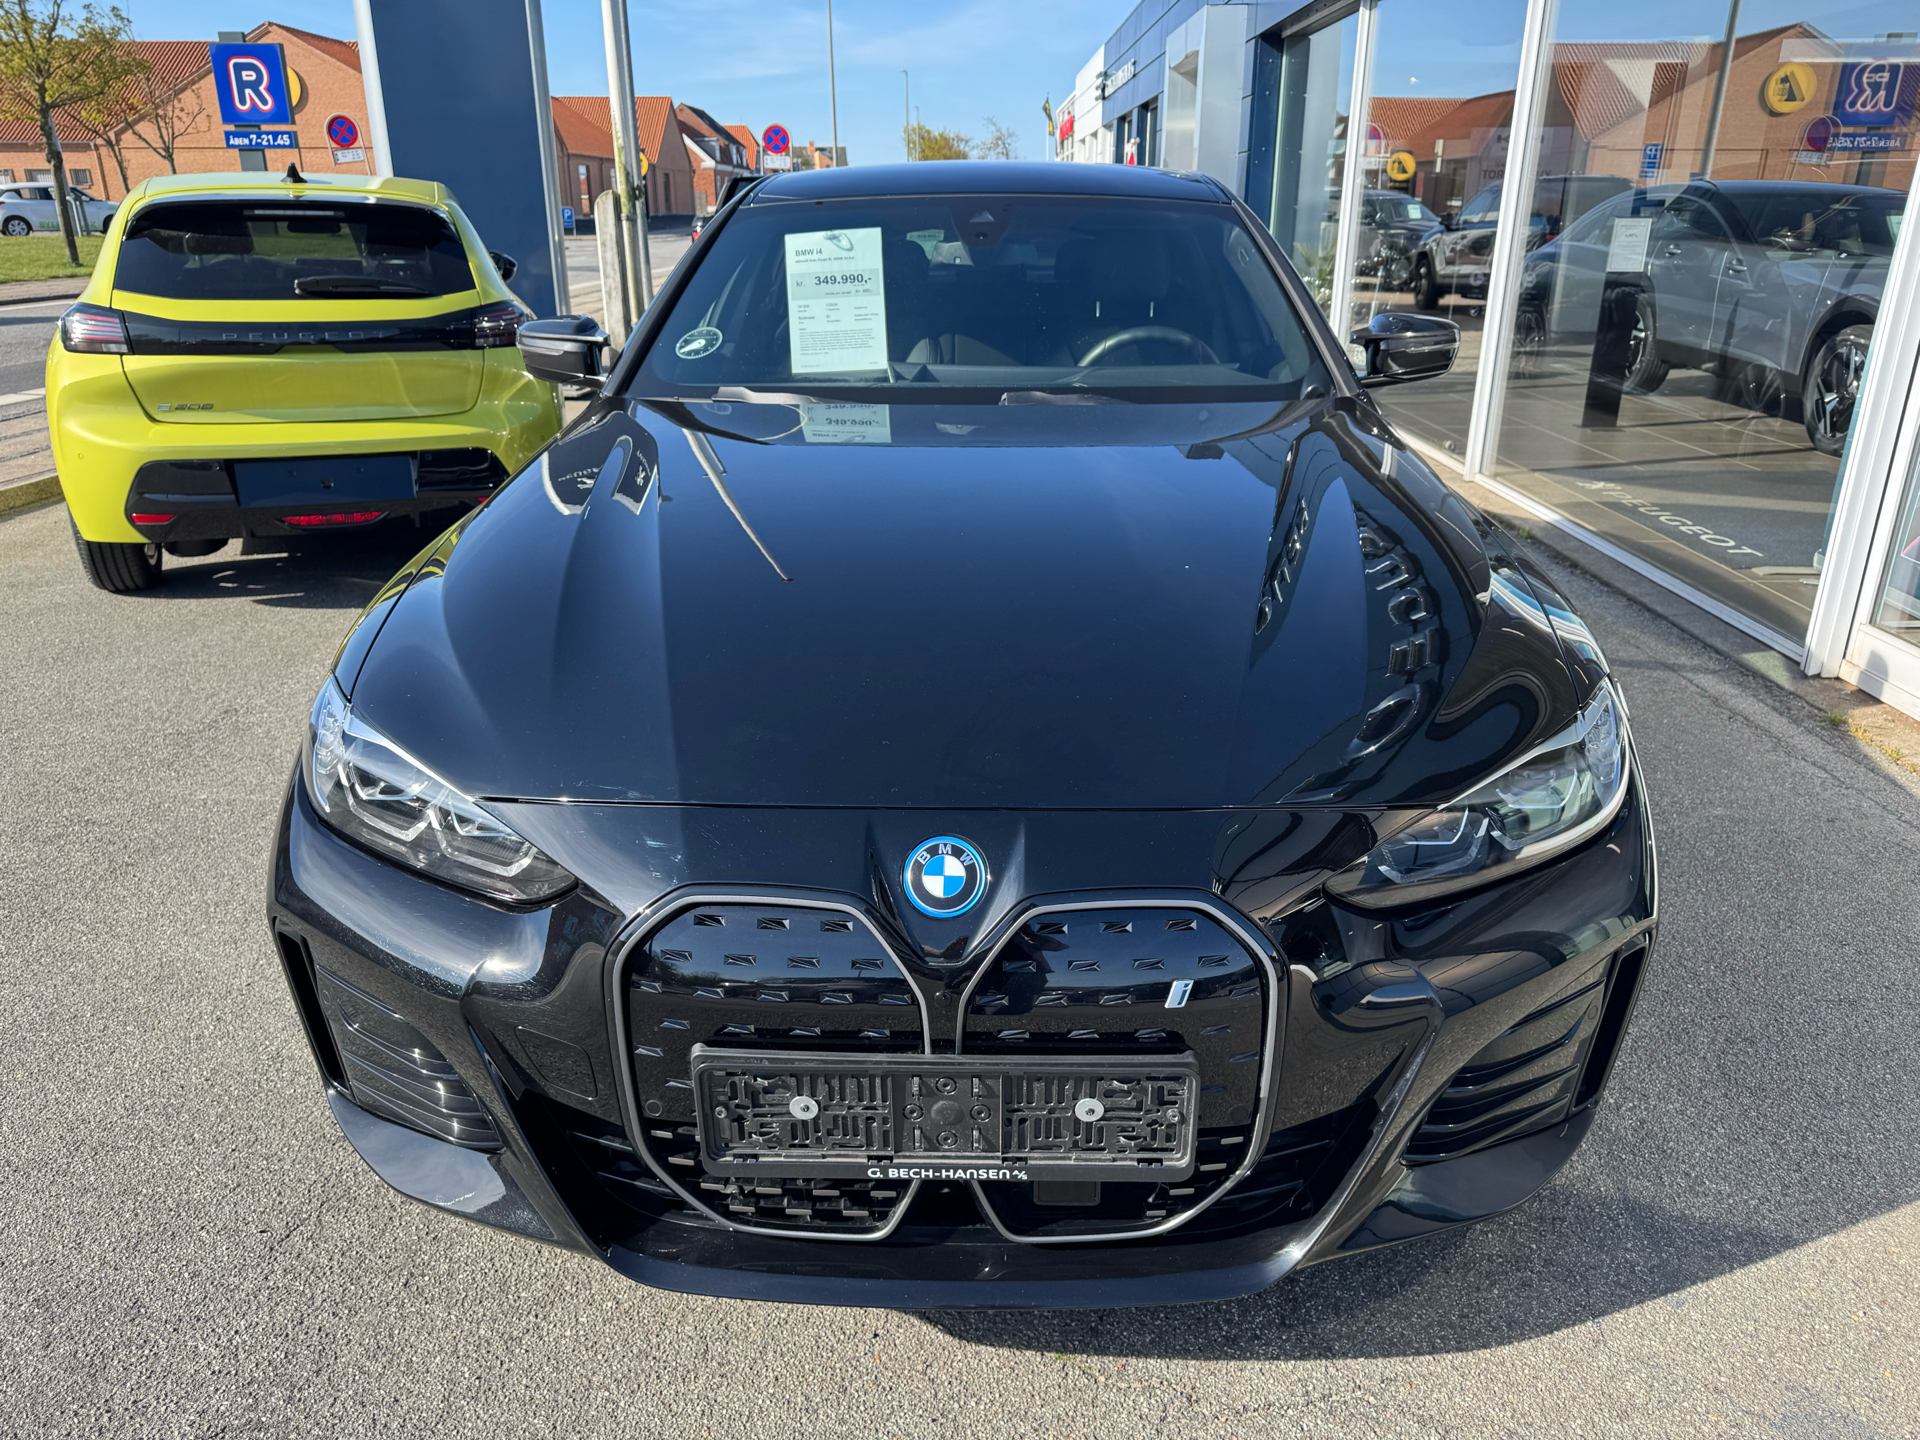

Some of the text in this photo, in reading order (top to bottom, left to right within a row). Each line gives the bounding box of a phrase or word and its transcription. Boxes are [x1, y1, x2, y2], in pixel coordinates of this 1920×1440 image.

[227, 56, 274, 112] R
[229, 134, 290, 146] ÅBEN 7-21.45
[564, 209, 571, 220] P
[795, 249, 814, 257] BMW
[814, 273, 872, 286] 349.990,-
[222, 331, 386, 340] PEUGEOT
[1602, 490, 1764, 557] PEUGEOT
[917, 843, 975, 866] BMW
[867, 1168, 883, 1179] G.
